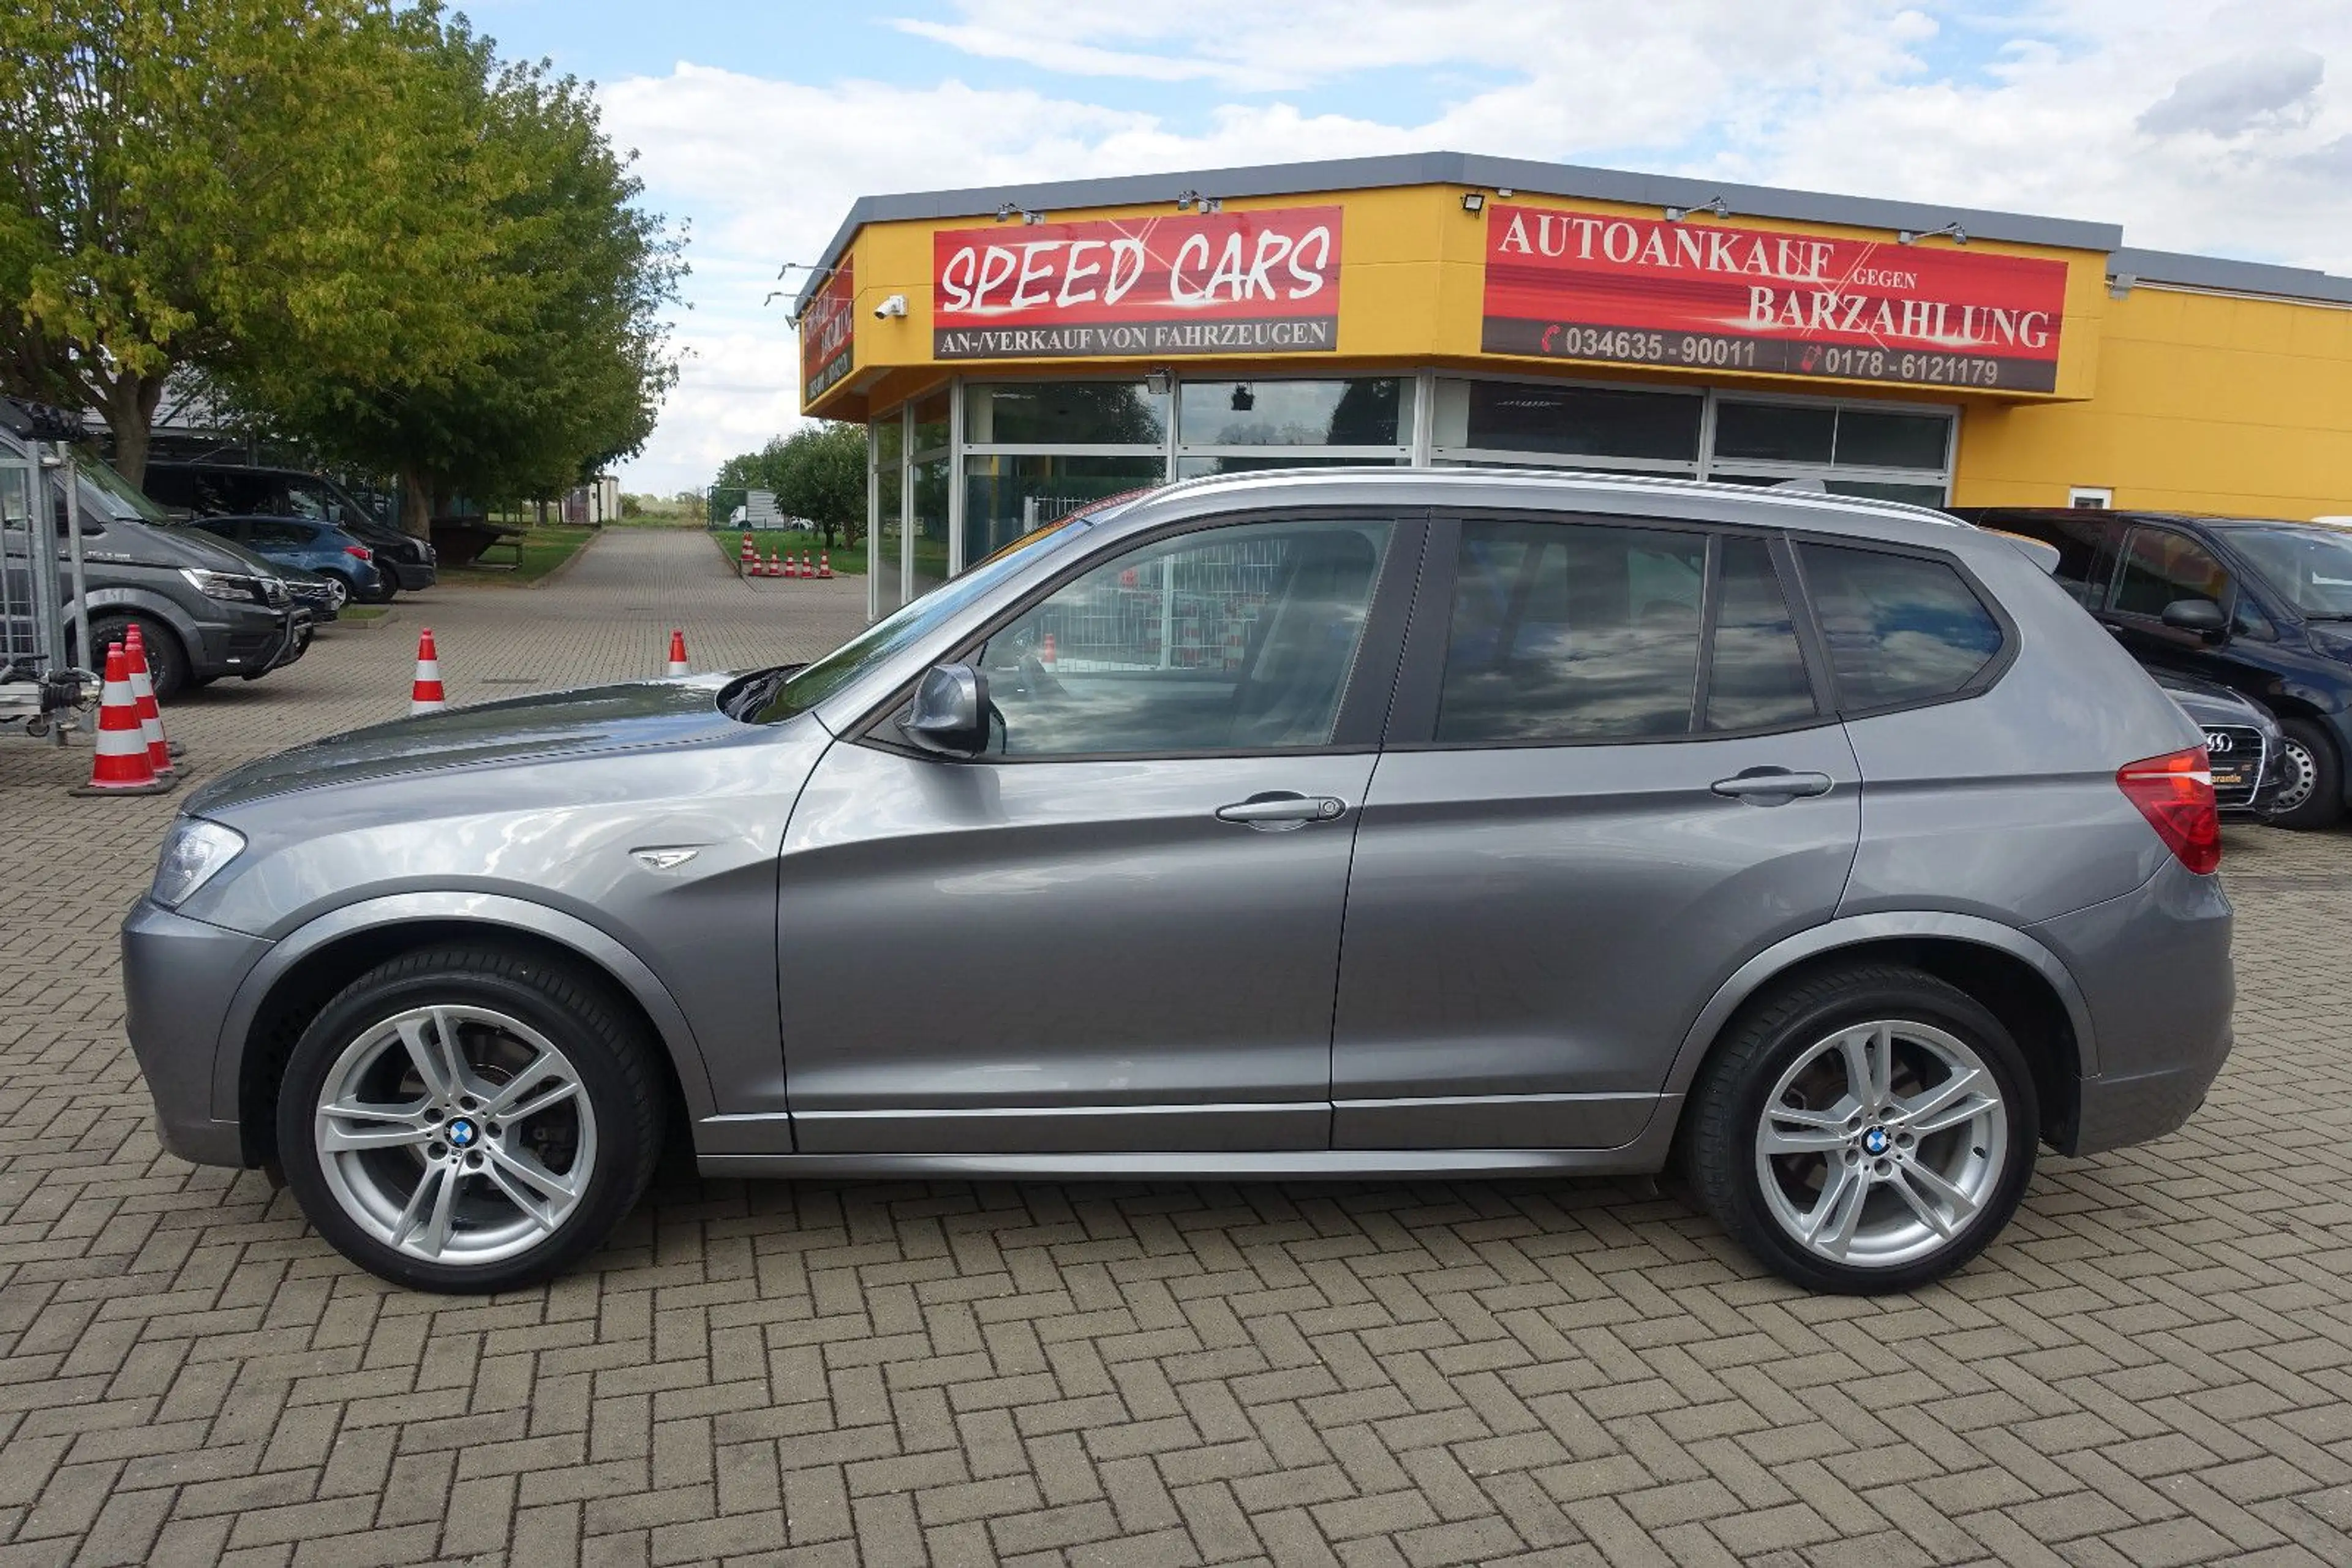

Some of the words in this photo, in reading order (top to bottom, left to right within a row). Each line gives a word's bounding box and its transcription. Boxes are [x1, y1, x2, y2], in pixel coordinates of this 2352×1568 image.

[943, 239, 1145, 312] SPEED
[1170, 226, 1330, 304] CARS
[1498, 211, 1834, 282] AUTOANKAUF
[1853, 268, 1918, 289] GEGEN
[1097, 327, 1147, 349] VON
[1155, 322, 1328, 347] FAHRZEUGEN
[1747, 285, 2049, 349] BARZAHLUNG
[2212, 773, 2241, 783] arantie
